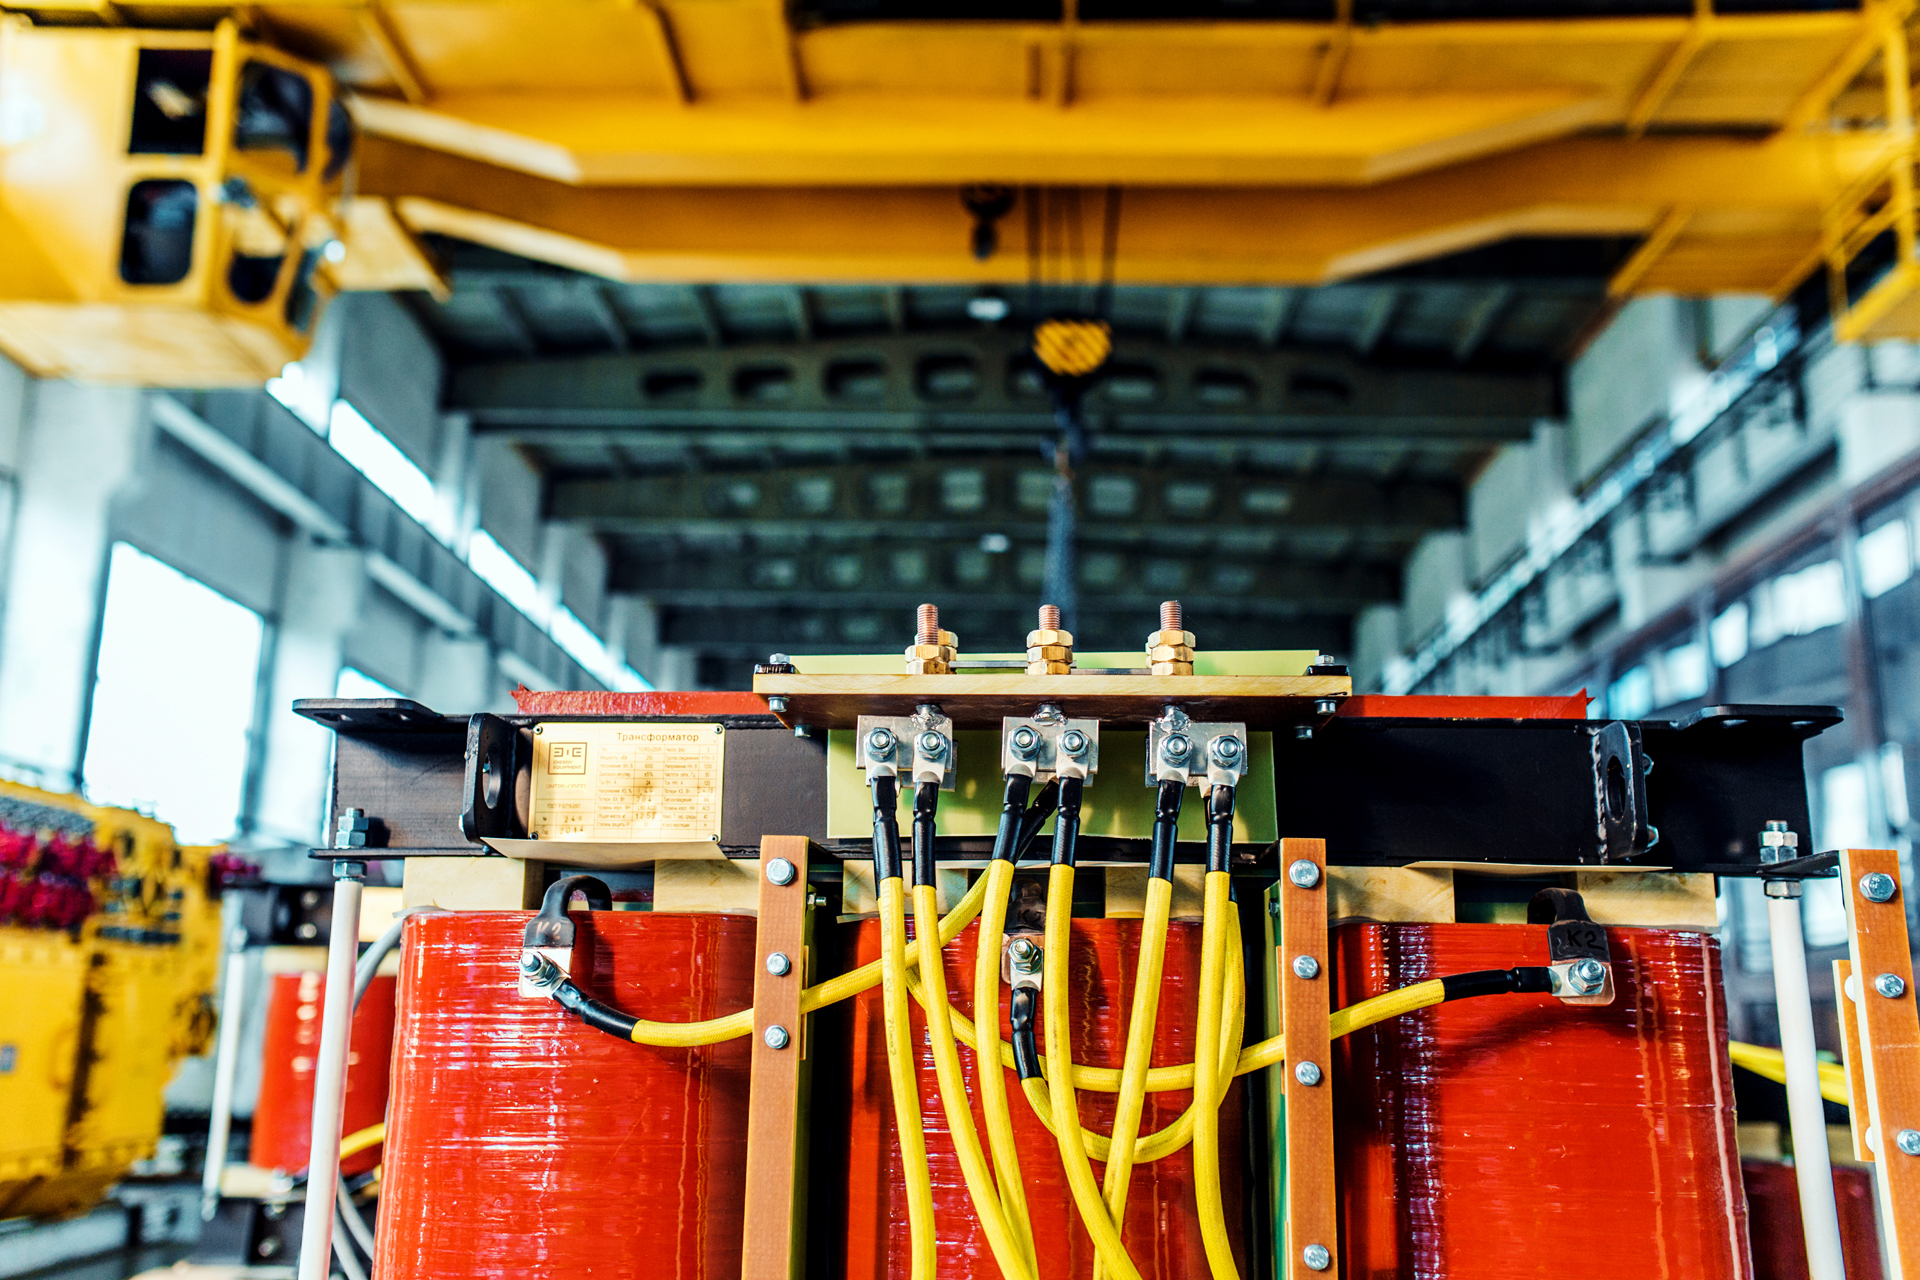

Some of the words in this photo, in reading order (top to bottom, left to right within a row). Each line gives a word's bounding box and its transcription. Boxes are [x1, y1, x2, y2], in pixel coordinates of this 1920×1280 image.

[616, 732, 699, 742] Трансформатор
[560, 826, 584, 834] 2014
[1566, 929, 1606, 950] K2
